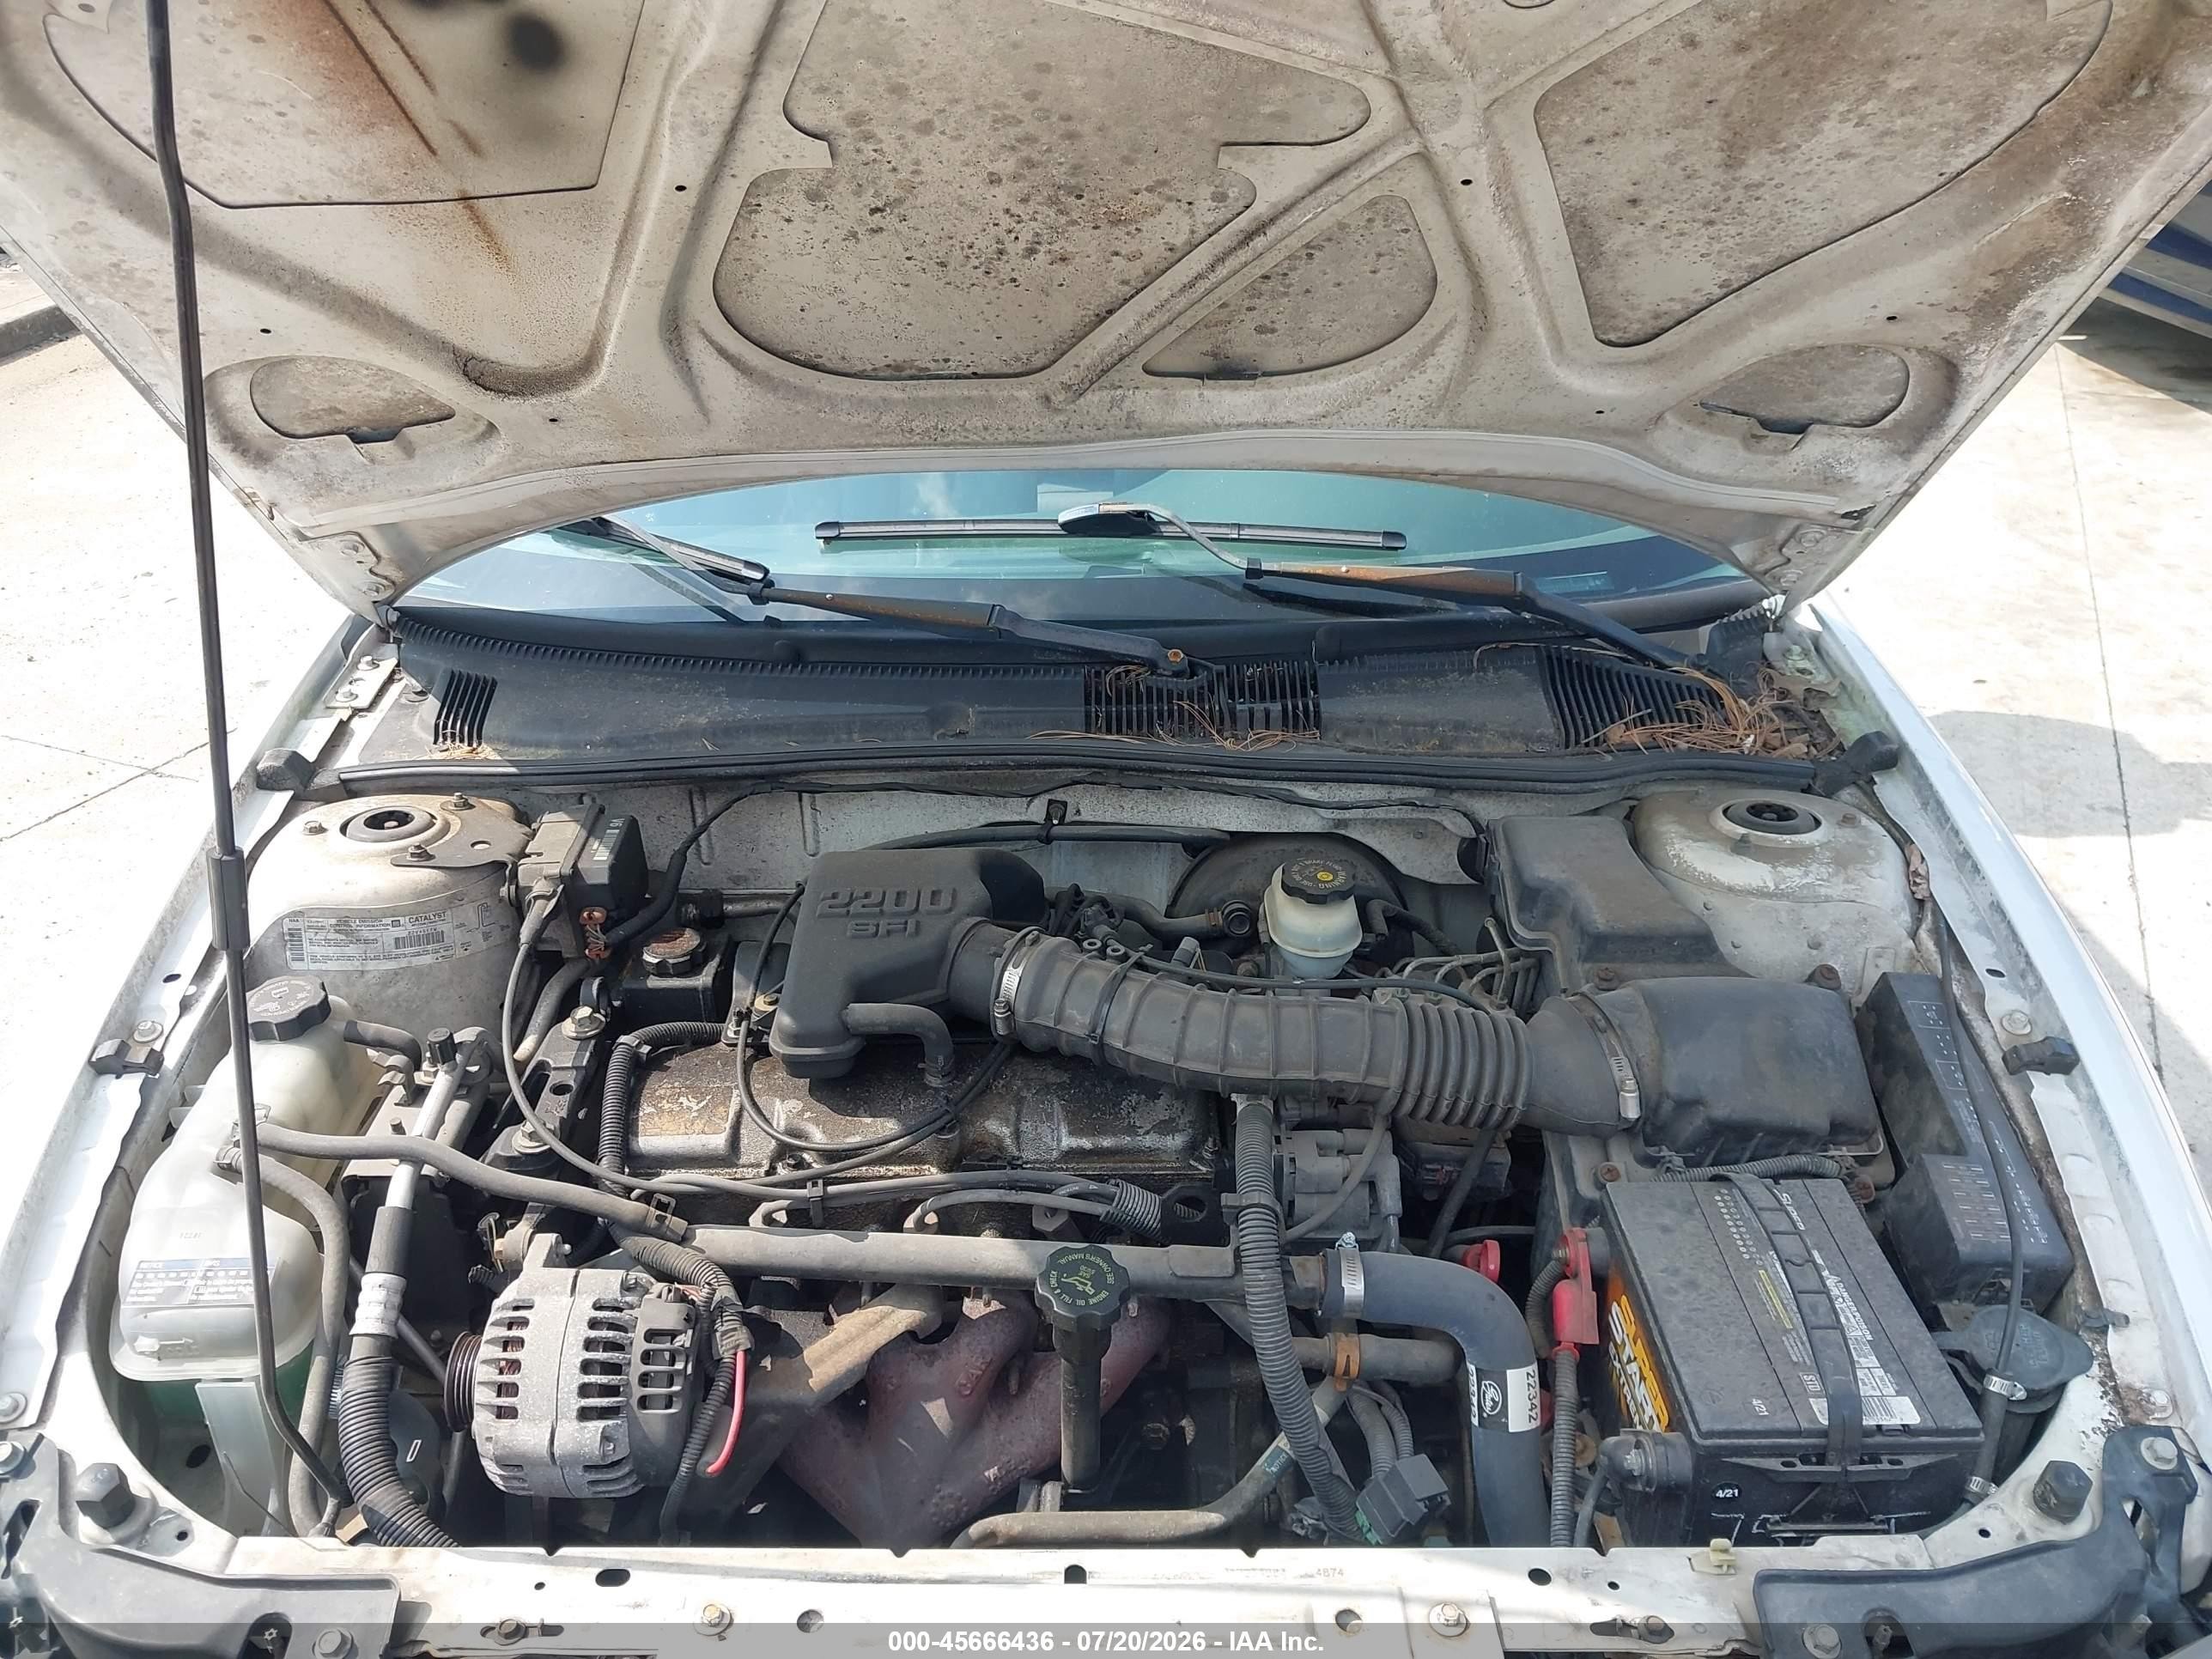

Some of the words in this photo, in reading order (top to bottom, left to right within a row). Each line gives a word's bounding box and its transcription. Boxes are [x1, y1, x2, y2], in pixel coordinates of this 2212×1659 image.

[1319, 871, 1346, 889] WARNING
[817, 886, 957, 918] 2200
[408, 911, 447, 924] CATALYST
[1057, 1253, 1085, 1265] MANUAL
[1049, 1270, 1058, 1288] CHECK
[1106, 1272, 1115, 1285] SEE
[1059, 1293, 1073, 1304] FILL
[1088, 1290, 1109, 1305] ENGINE
[1620, 1295, 1669, 1433] SUPER
[1525, 1369, 1539, 1424] 22342
[1715, 1489, 1739, 1498] 4/21
